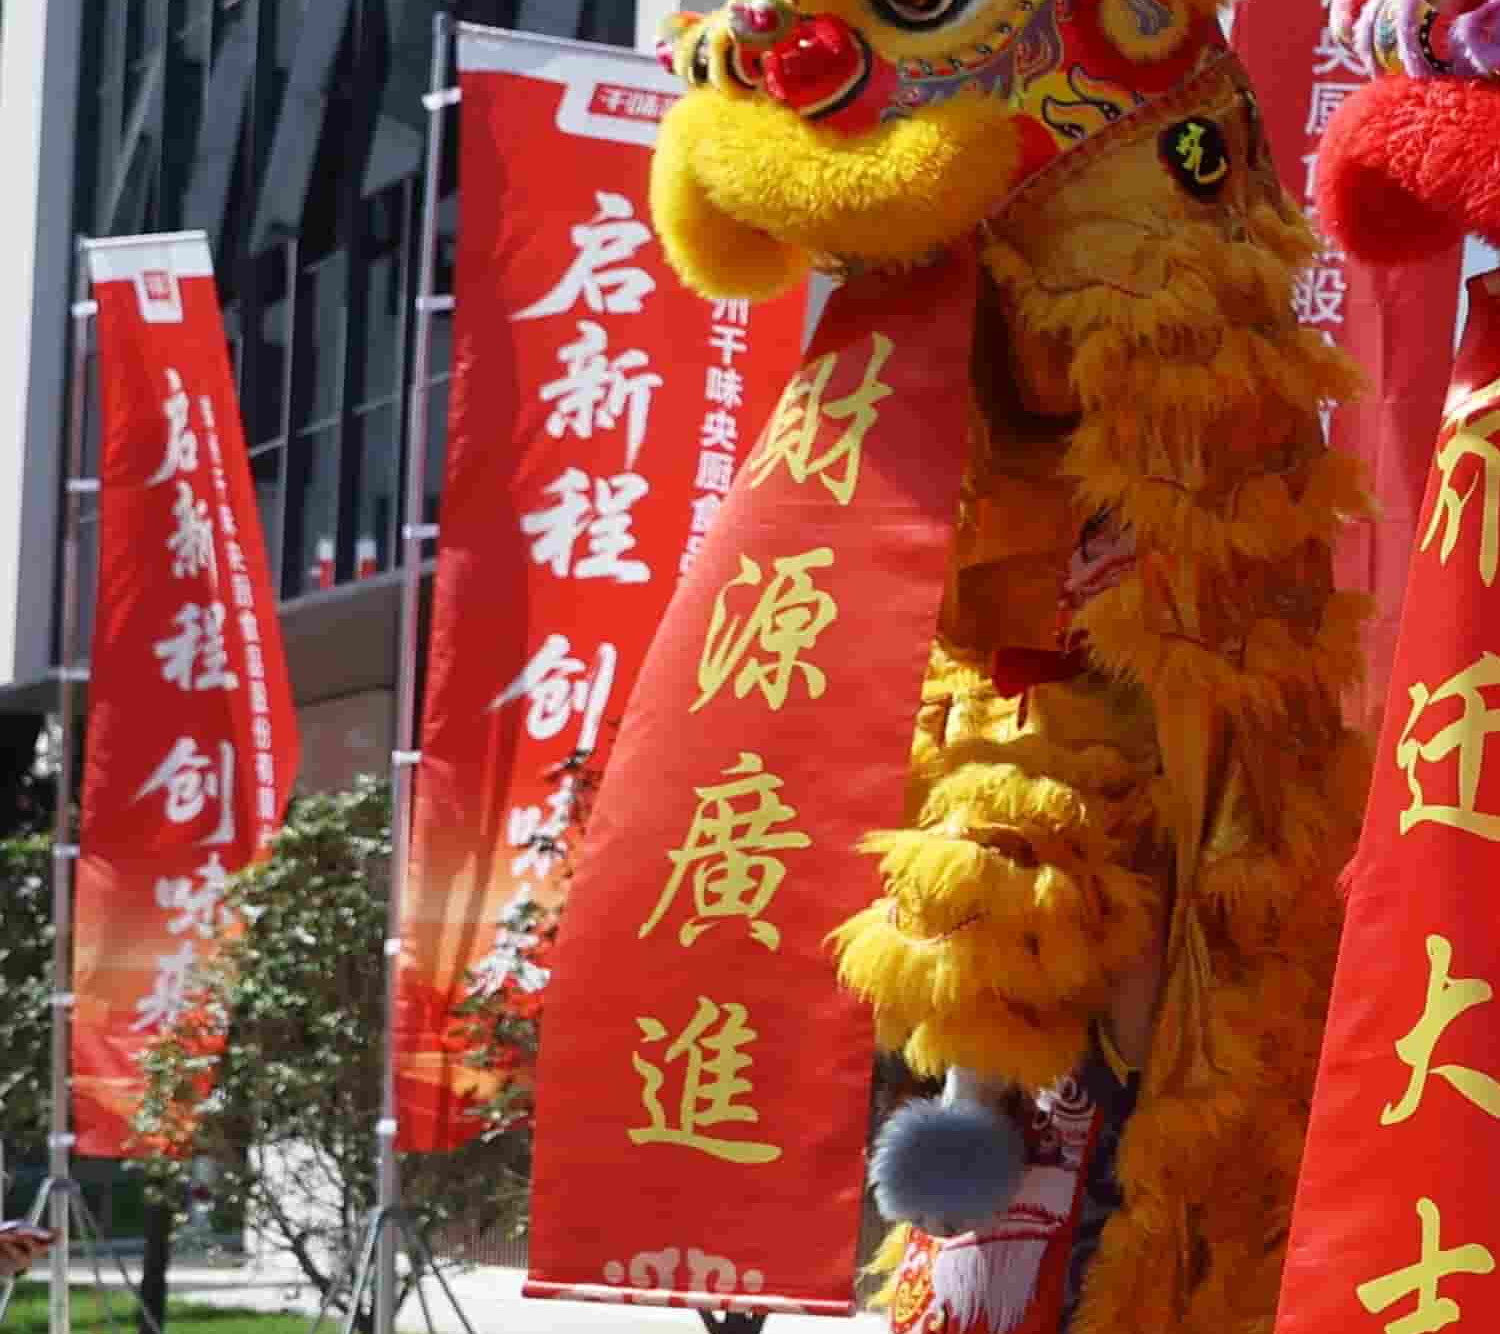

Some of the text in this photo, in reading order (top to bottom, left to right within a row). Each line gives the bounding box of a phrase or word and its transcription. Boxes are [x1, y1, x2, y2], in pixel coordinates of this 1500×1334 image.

[512, 191, 663, 584] 启新程
[627, 332, 896, 1165] 財源廣進
